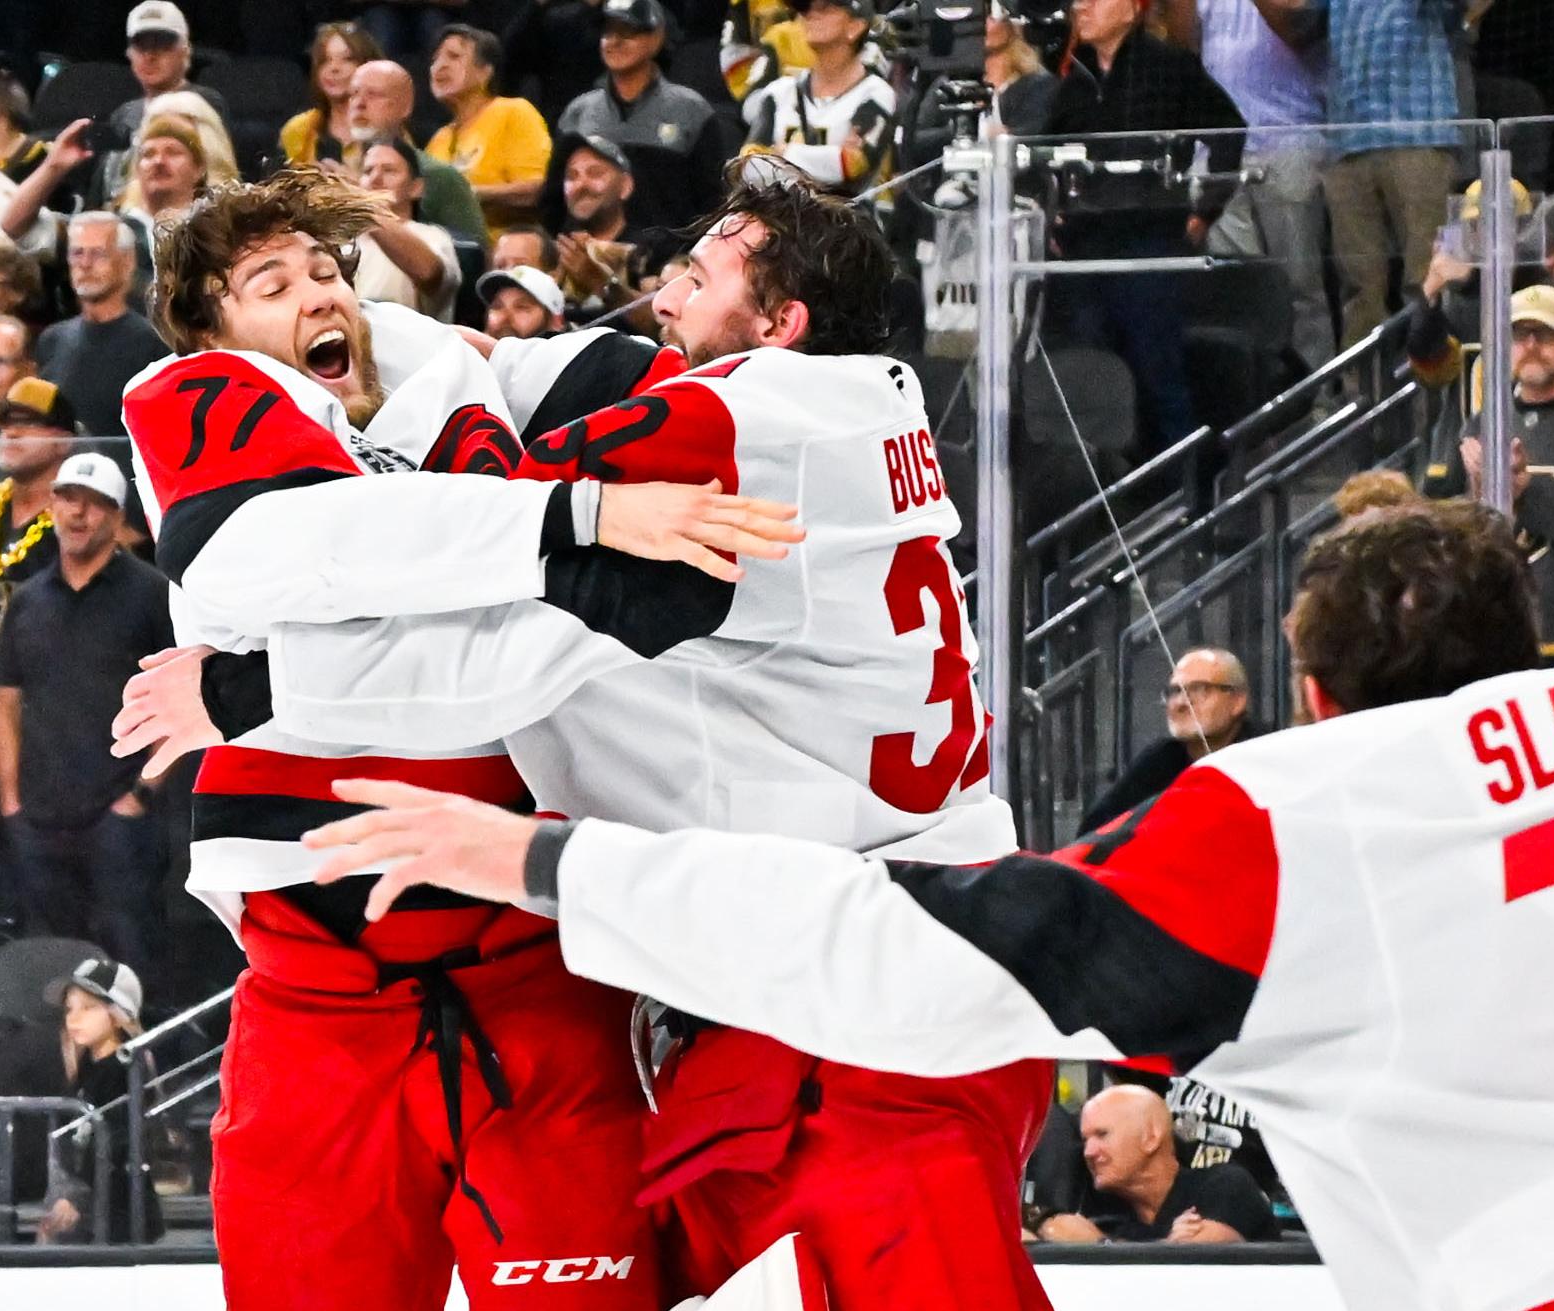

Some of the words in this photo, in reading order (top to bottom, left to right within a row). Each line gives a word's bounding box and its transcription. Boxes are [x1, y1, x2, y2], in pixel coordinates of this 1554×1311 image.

[883, 429, 950, 515] BUS
[868, 535, 995, 815] 3
[491, 1255, 636, 1287] CCM
